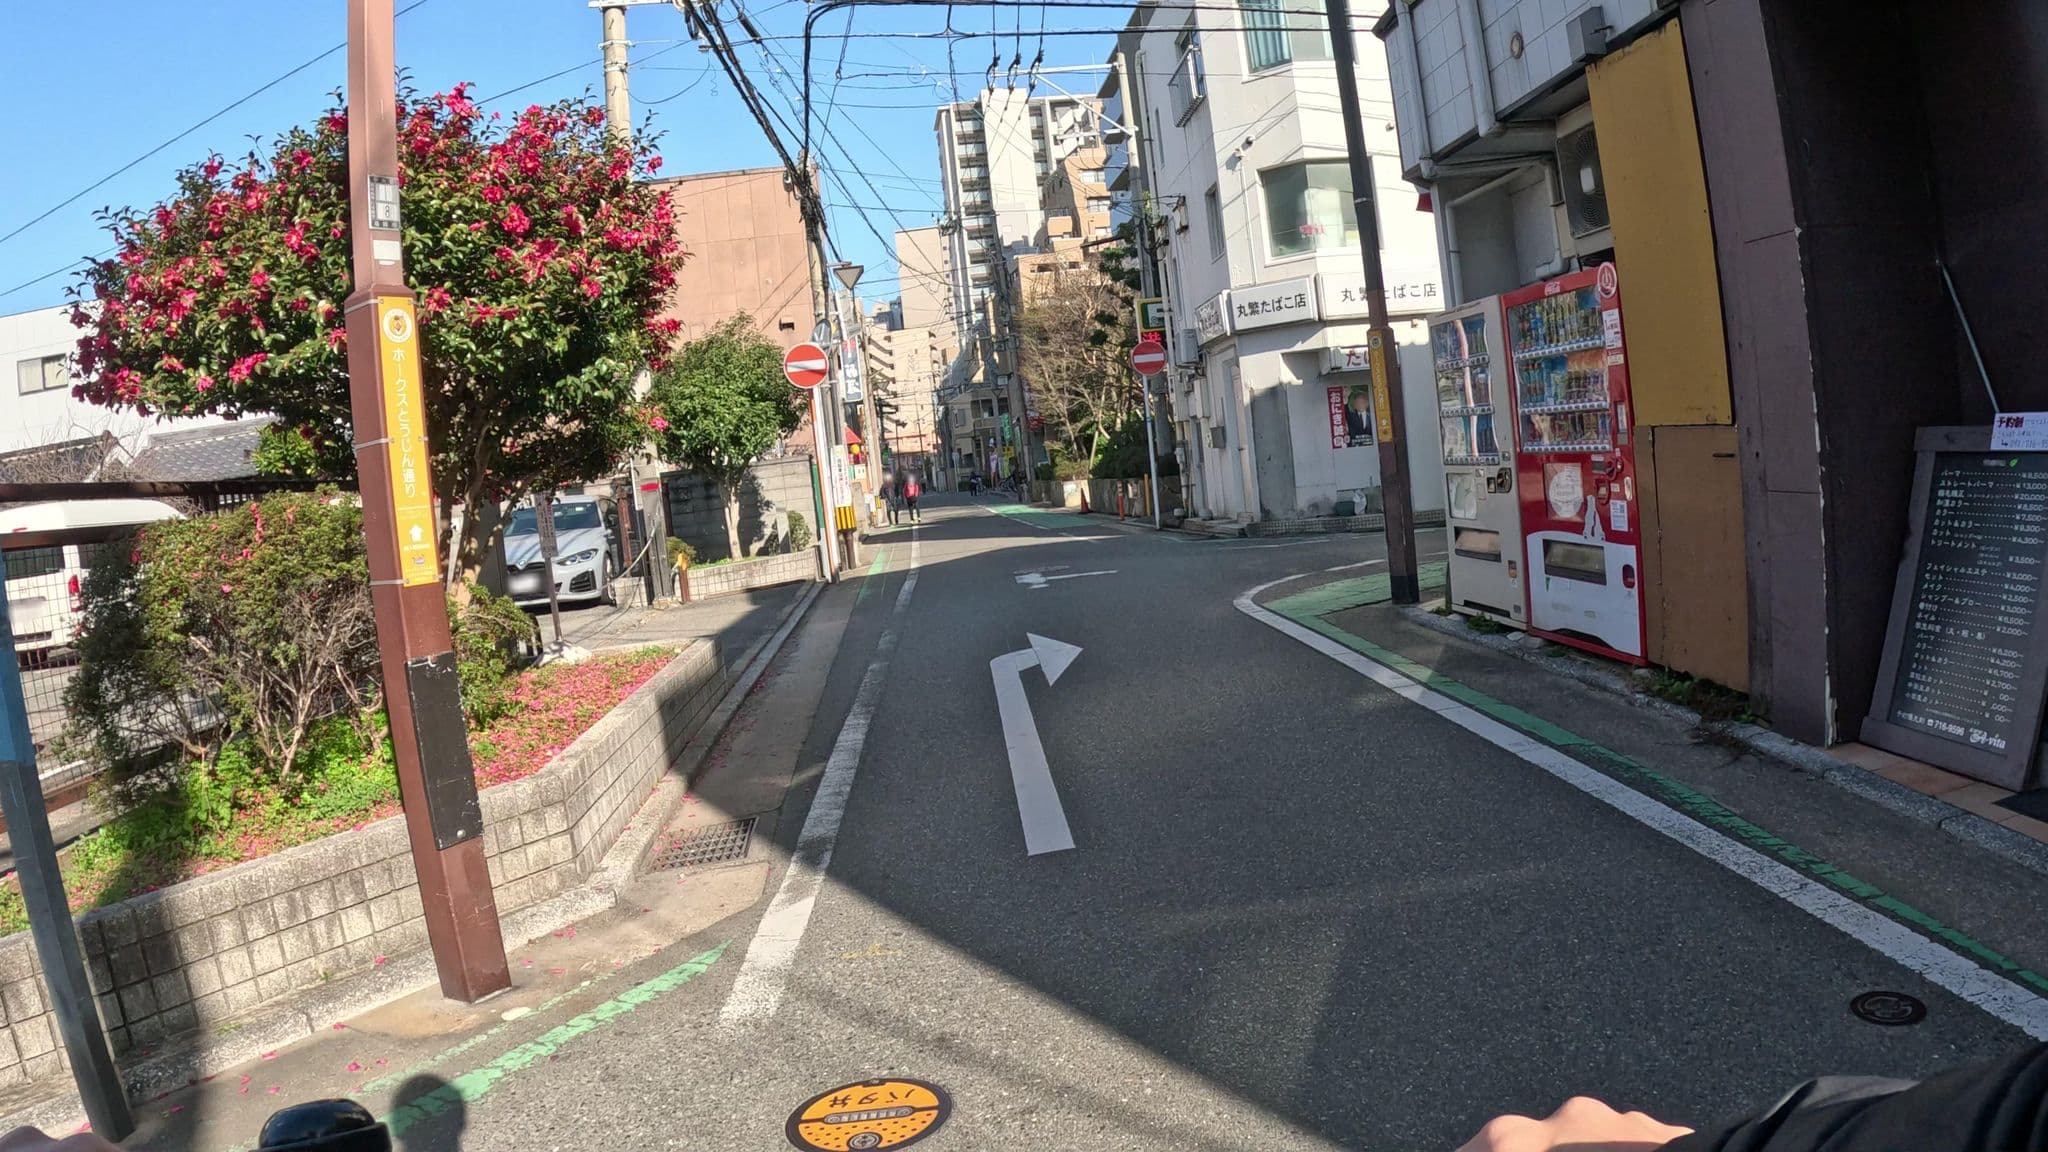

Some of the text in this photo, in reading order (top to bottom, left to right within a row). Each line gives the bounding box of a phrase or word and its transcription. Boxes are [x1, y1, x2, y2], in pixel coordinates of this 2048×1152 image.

[1236, 293, 1307, 318] 丸繁たばこ店
[392, 348, 417, 498] ホークスとうじん通り
[829, 1089, 915, 1108] バタ弁
